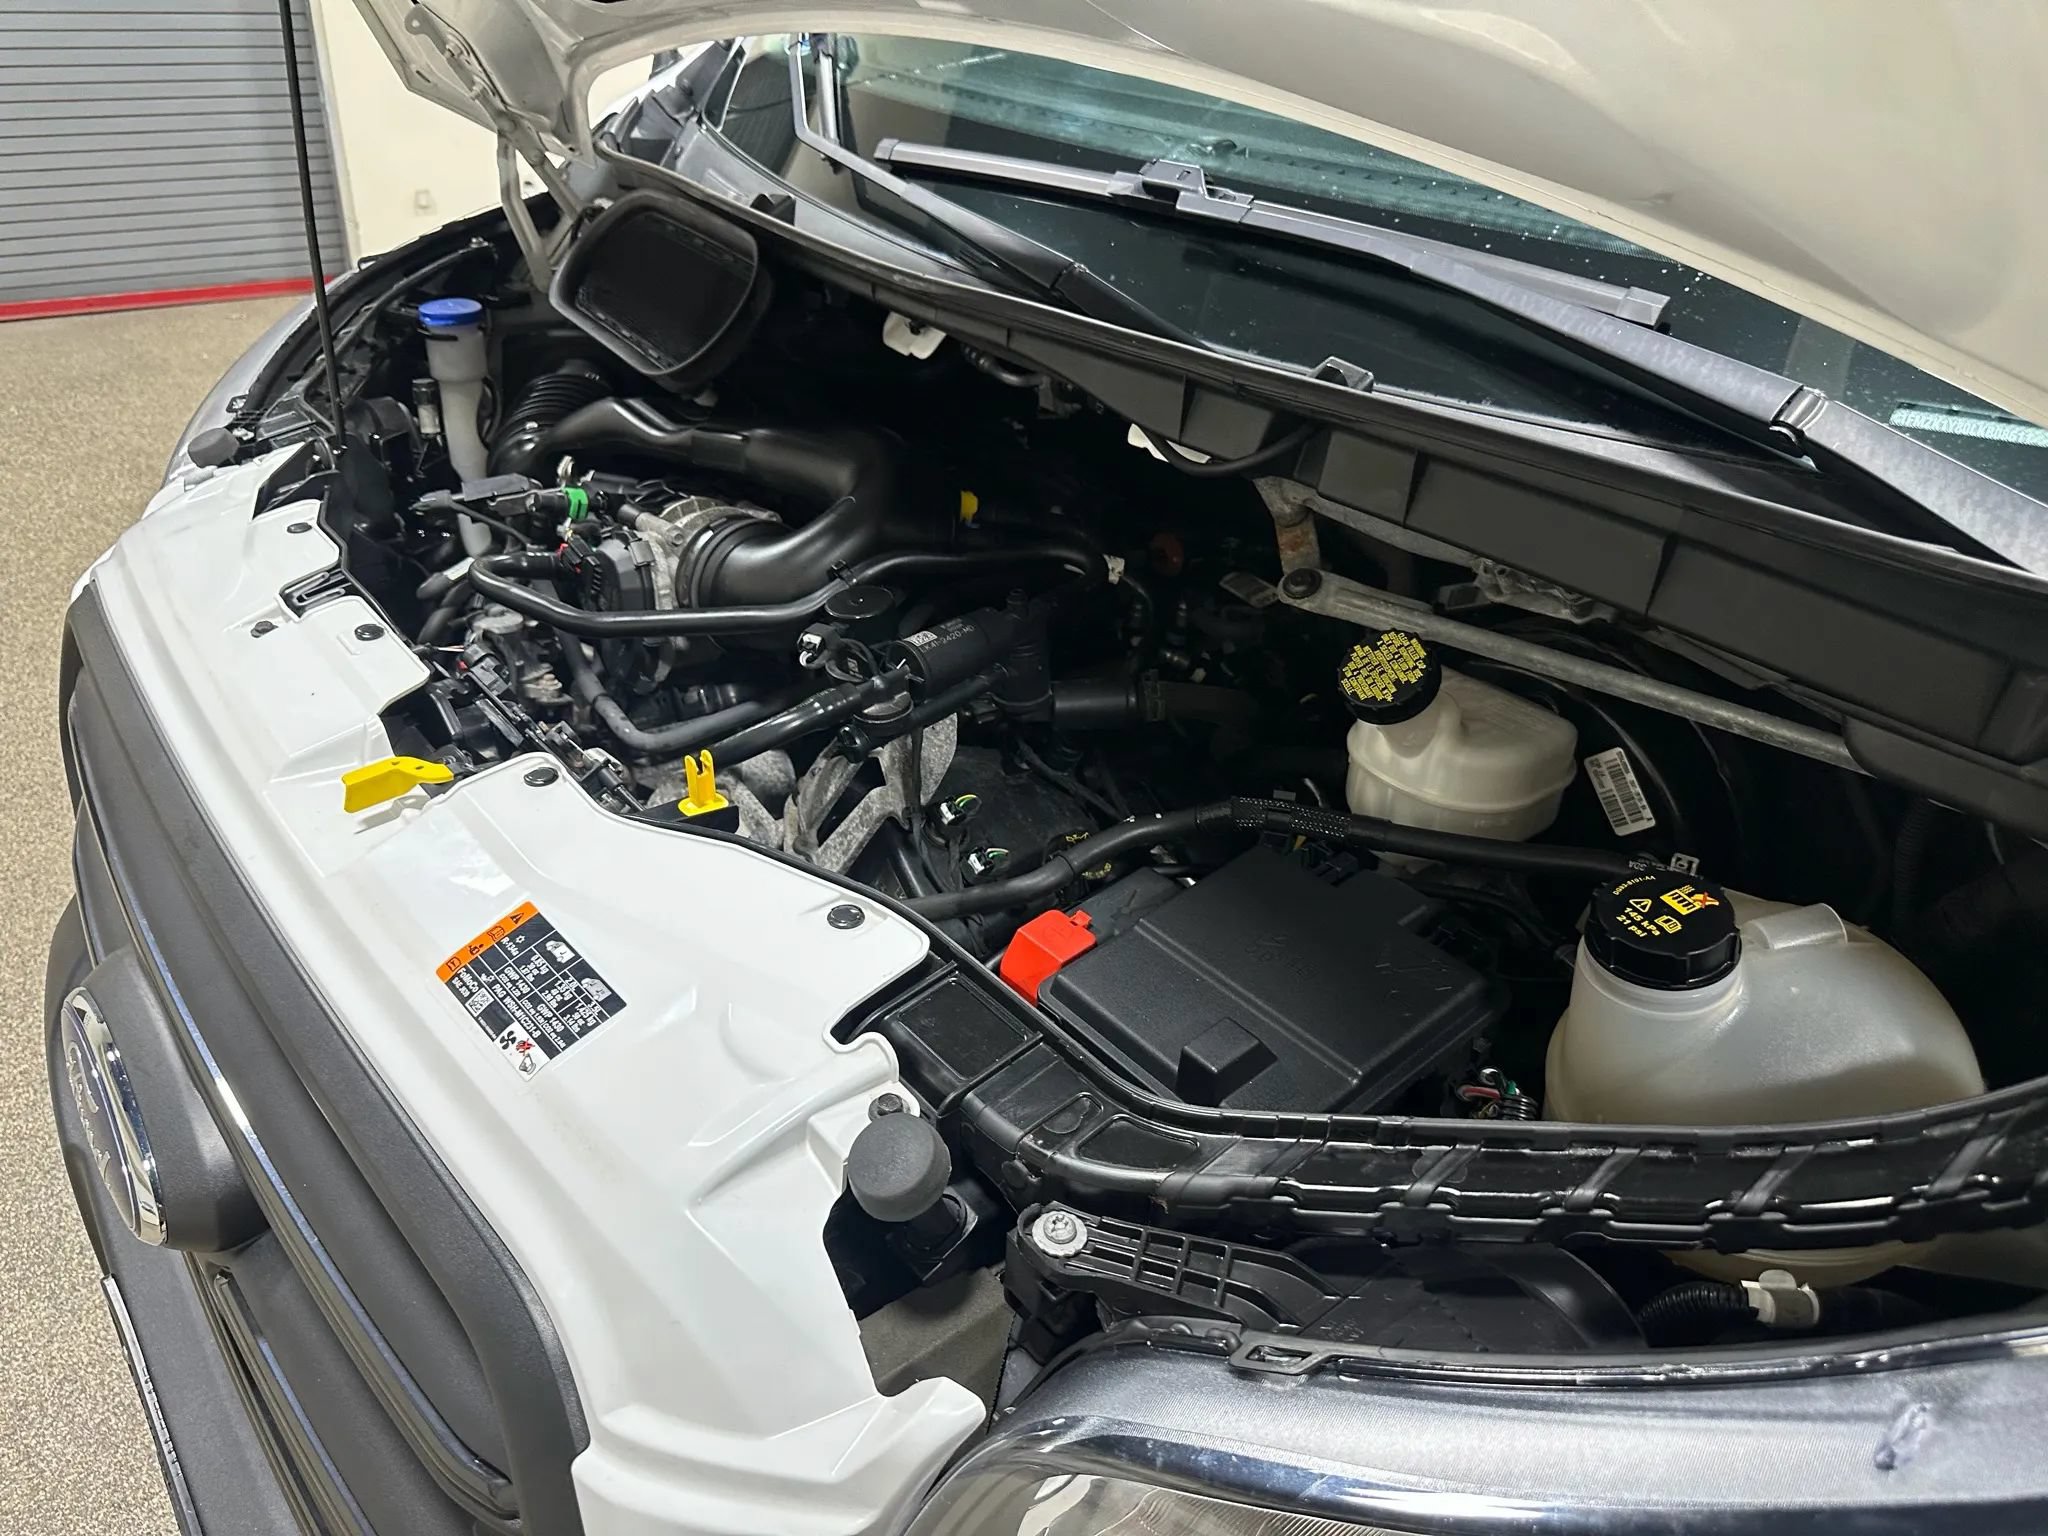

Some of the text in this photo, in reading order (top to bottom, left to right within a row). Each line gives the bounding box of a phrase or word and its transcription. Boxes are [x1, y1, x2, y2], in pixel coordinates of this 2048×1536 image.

[1616, 915, 1647, 938] 21 psi
[1625, 908, 1661, 936] 145 kPa
[456, 967, 481, 993] FoMoCo
[491, 983, 506, 998] PAG
[503, 966, 530, 994] GWP 1430
[536, 1003, 564, 1032] GWP 1430
